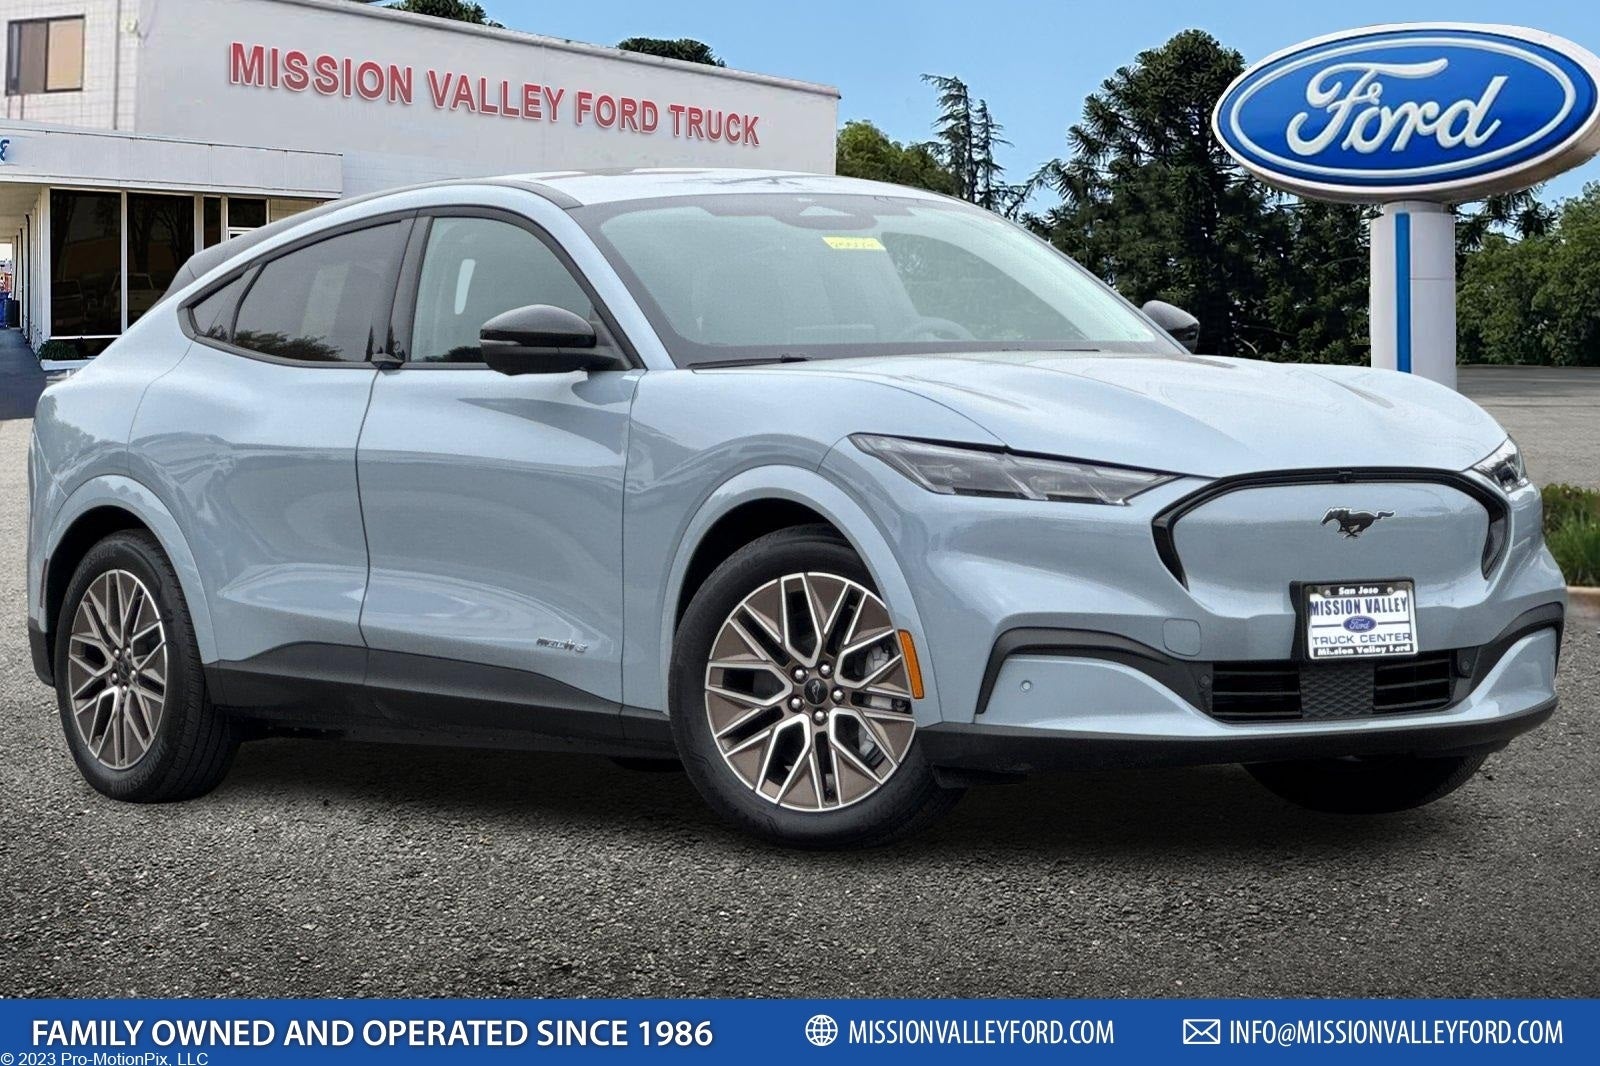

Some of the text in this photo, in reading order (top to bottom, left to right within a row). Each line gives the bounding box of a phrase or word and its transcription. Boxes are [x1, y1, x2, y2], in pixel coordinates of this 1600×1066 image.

[229, 41, 761, 146] MISSION VALLEY FORD TRUCK
[1286, 57, 1509, 157] Ford
[1339, 586, 1379, 595] San Jose
[1310, 597, 1407, 616] MISSION VALLEY
[1349, 618, 1370, 630] Ford
[1312, 632, 1412, 645] TRUCK CENTER
[1356, 644, 1387, 655] Valley
